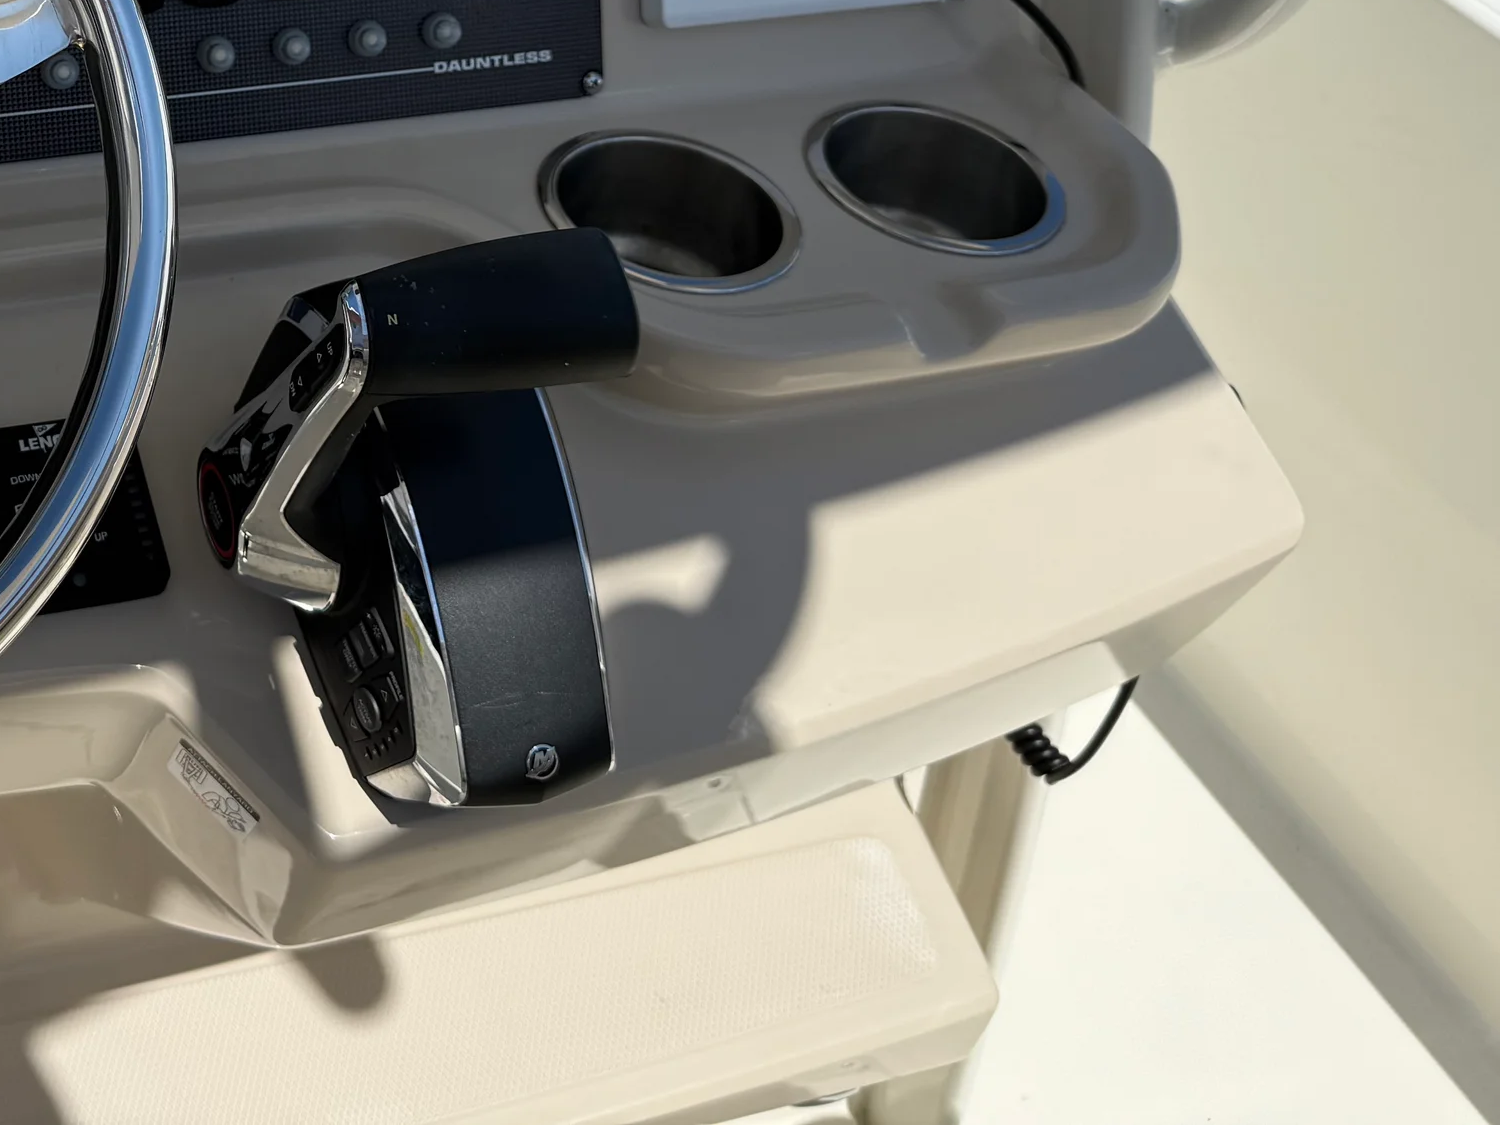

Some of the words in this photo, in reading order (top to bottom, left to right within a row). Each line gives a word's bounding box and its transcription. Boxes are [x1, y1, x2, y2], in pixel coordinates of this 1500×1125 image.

[434, 49, 553, 74] DAUNTLESS
[387, 313, 399, 326] N
[94, 531, 108, 542] UP
